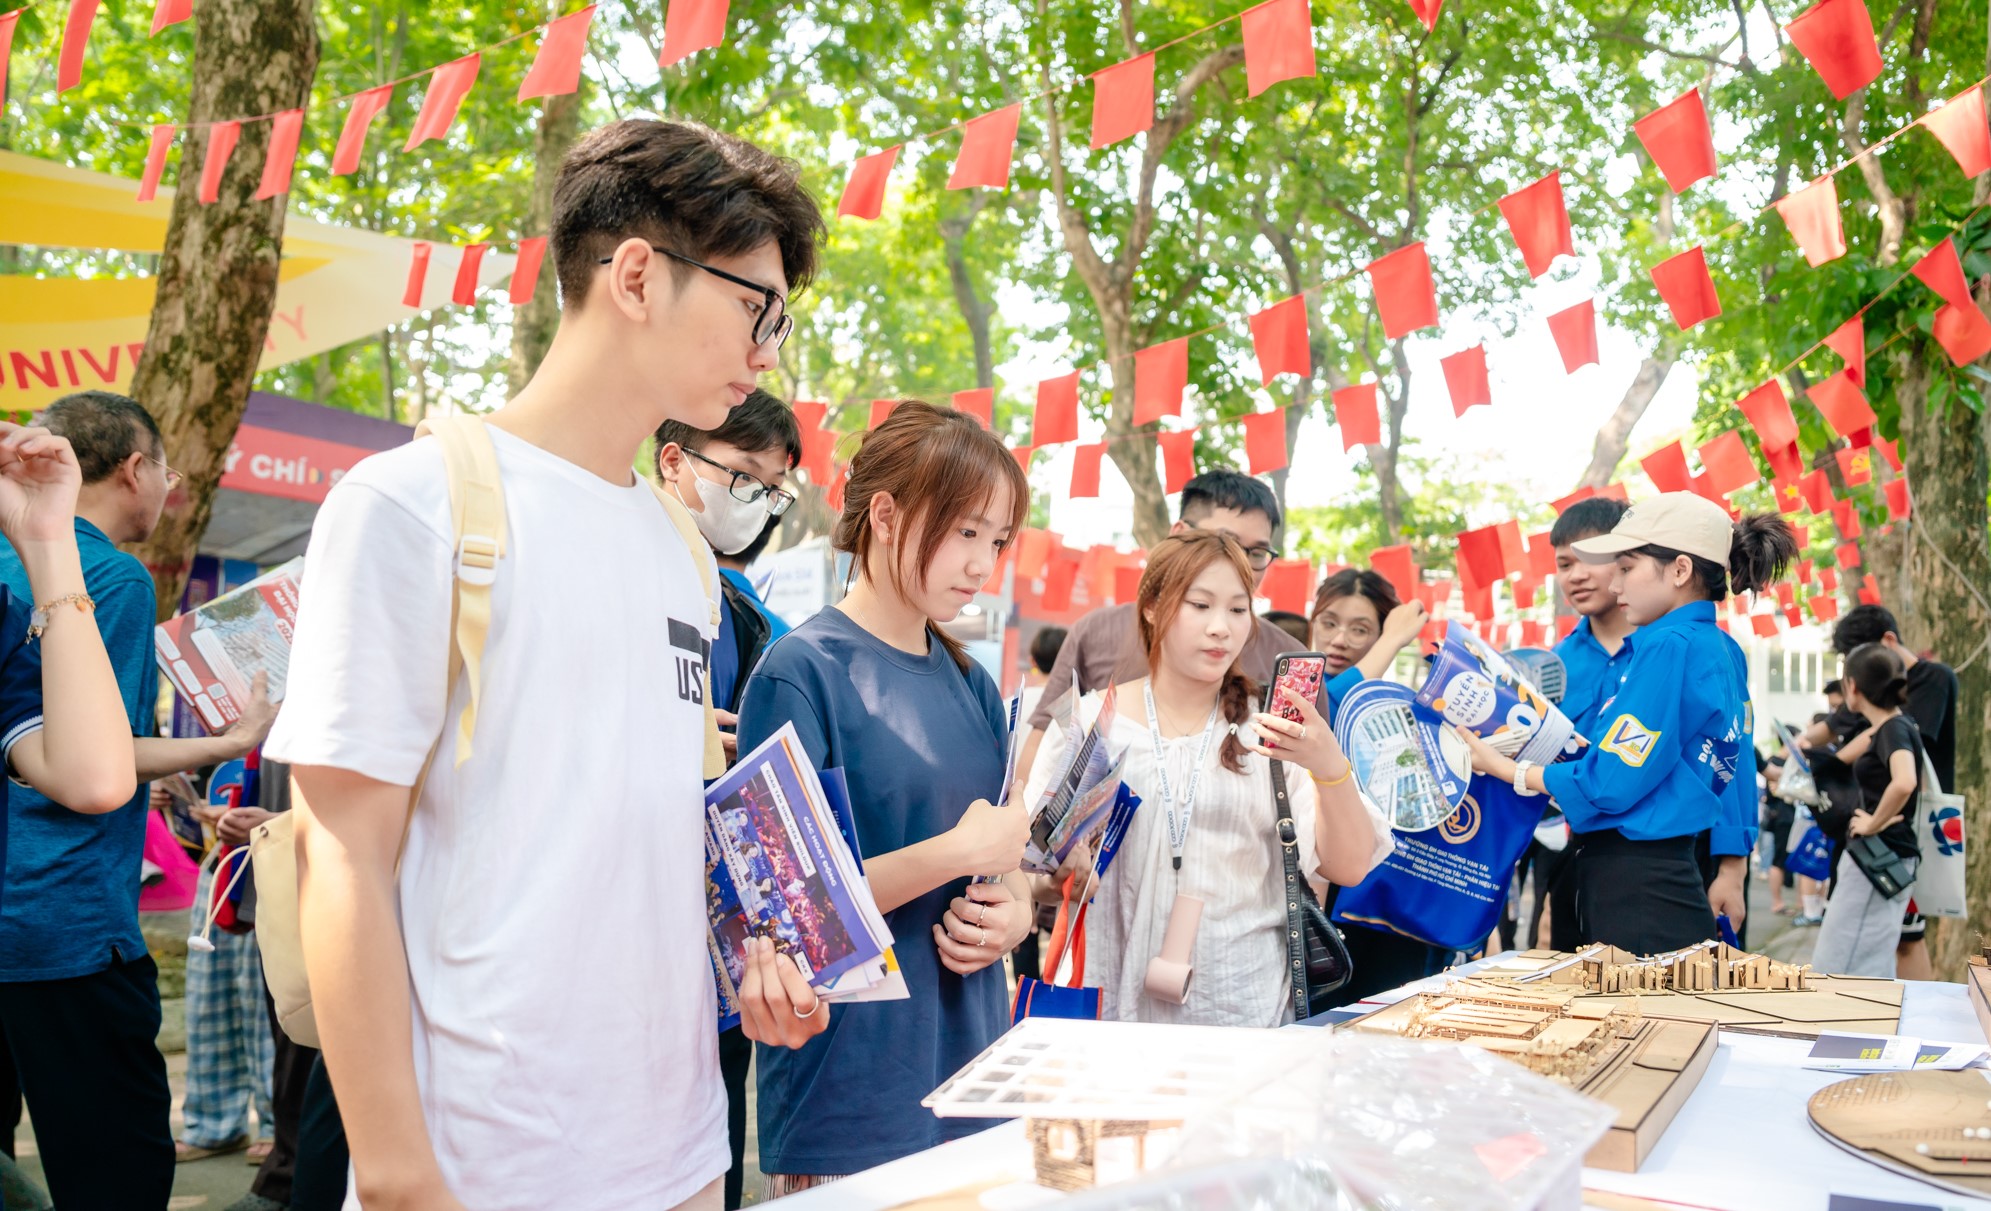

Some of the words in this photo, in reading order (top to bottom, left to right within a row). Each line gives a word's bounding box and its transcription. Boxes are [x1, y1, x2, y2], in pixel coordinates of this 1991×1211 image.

[250, 454, 308, 485] CHÍ
[1456, 690, 1479, 718] SINH
[1477, 689, 1490, 709] HỌC
